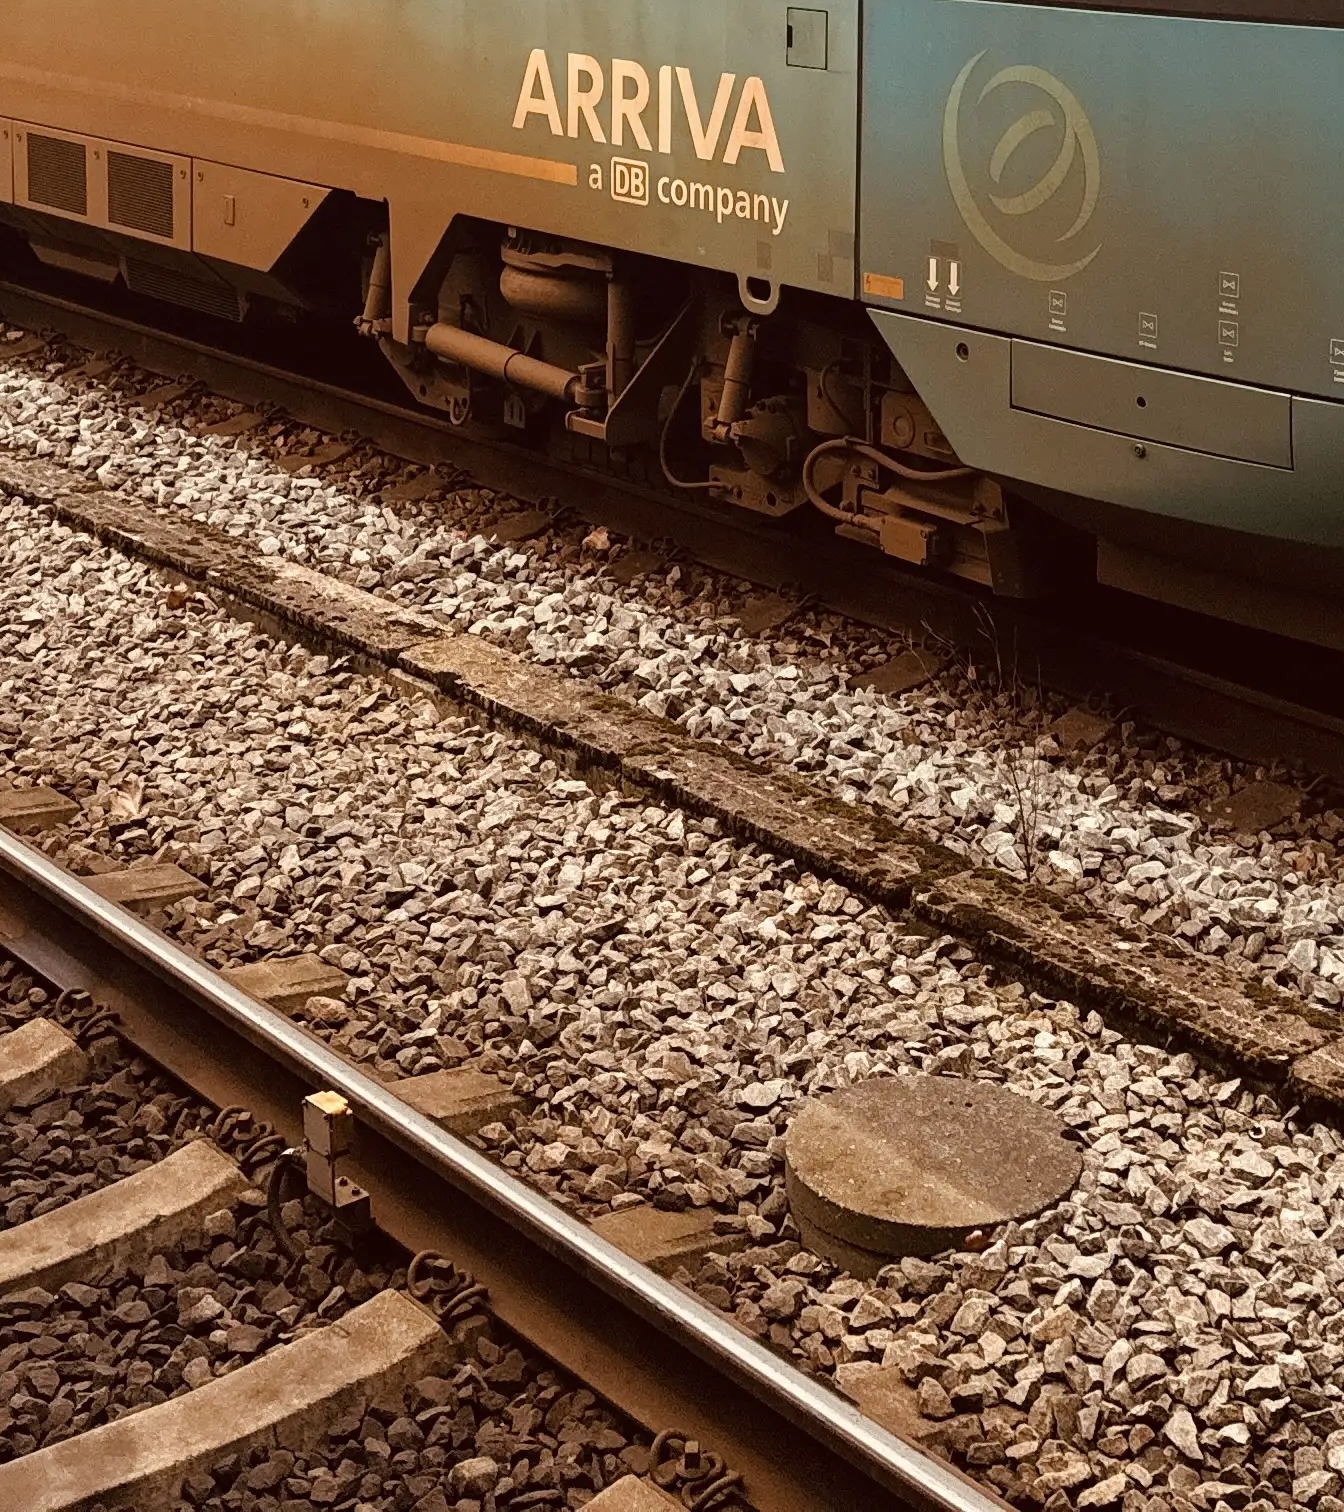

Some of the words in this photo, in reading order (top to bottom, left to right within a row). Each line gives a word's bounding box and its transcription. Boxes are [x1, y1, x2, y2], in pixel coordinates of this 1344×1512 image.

[512, 48, 786, 174] ARRIVA
[588, 162, 603, 191] a
[613, 163, 646, 201] DB
[657, 174, 789, 236] company
